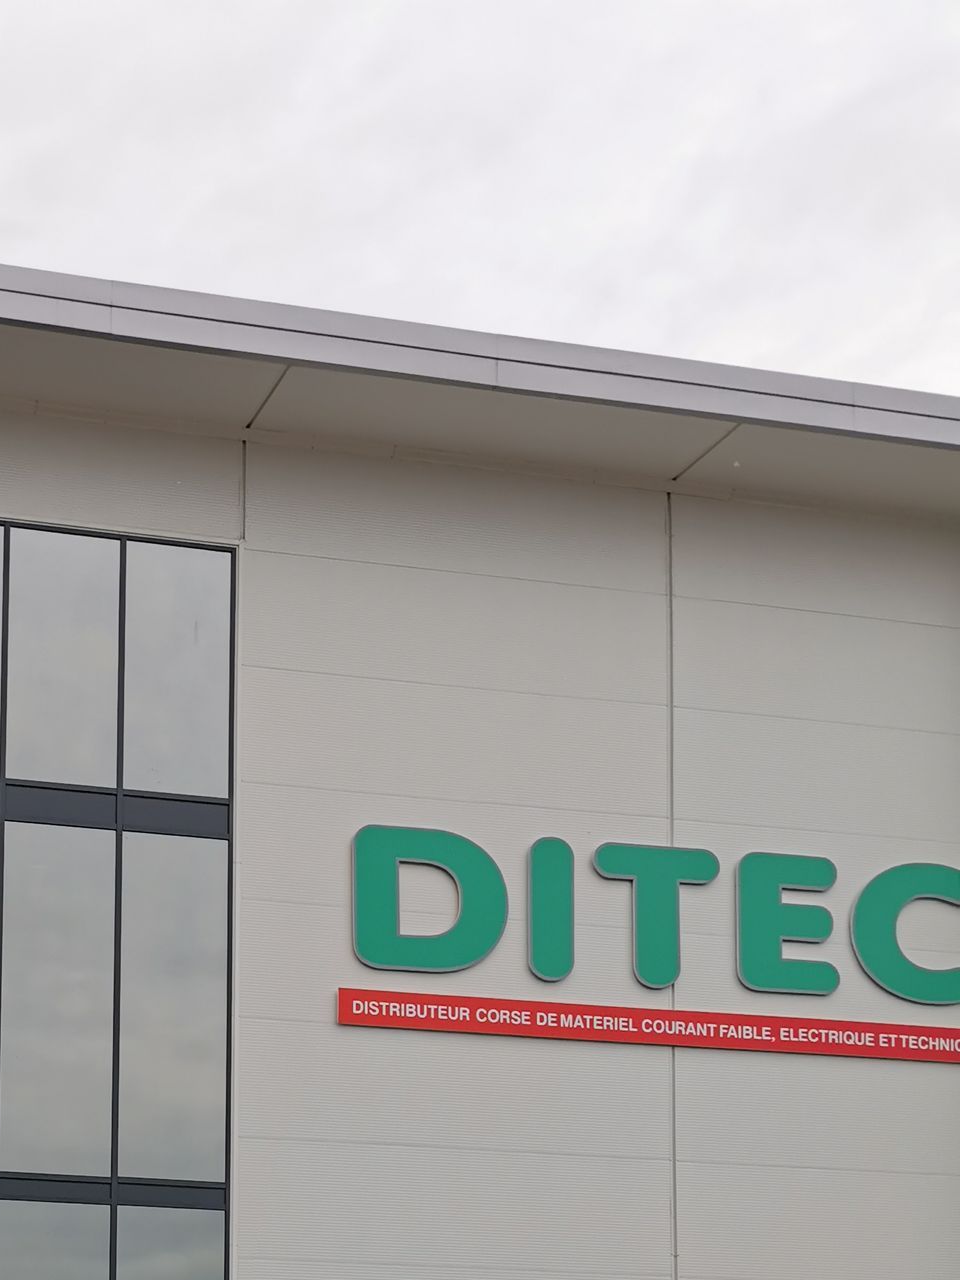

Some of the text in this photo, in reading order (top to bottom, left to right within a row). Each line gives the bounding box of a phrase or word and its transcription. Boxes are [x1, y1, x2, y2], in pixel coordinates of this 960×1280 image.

[351, 824, 960, 1005] DITEC
[352, 1000, 470, 1021] DISTRIBUTEUR
[475, 1008, 531, 1025] CORSE
[536, 1012, 558, 1027] DE
[560, 1014, 637, 1032] MATERIEL
[641, 1019, 717, 1038] COURANT
[719, 1025, 776, 1043] FAIBLE,
[780, 1027, 875, 1047] ELECTRIQUE
[879, 1034, 898, 1048] ET
